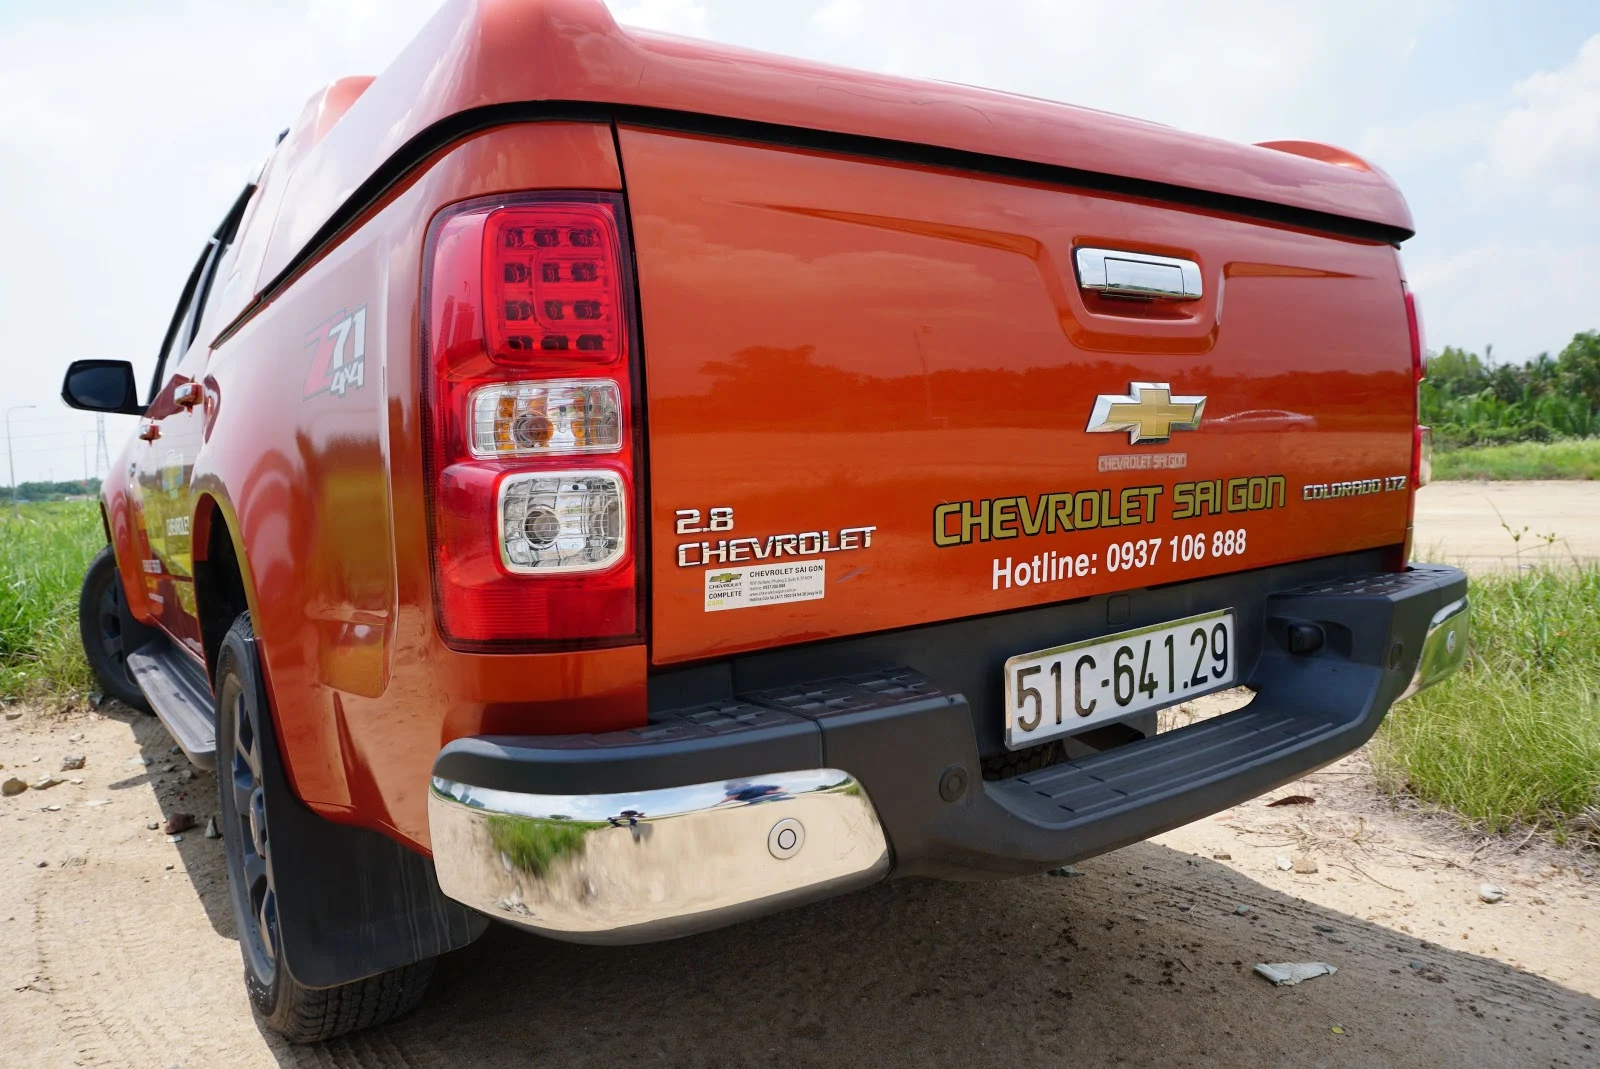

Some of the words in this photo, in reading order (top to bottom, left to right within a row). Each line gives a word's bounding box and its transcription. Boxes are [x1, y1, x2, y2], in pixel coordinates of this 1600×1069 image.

[303, 302, 367, 402] Z71
[1303, 479, 1381, 500] COLORADO
[1384, 476, 1406, 492] LTZ
[675, 507, 734, 534] 2.8
[932, 485, 1163, 548] CHEVROLET
[1172, 478, 1222, 520] SAI
[1226, 475, 1286, 512] GON
[678, 526, 877, 567] CHEVROLET
[992, 552, 1098, 591] Hotline:
[1106, 538, 1162, 573] 0937
[1169, 532, 1206, 563] 106
[1211, 528, 1247, 558] 888
[709, 582, 742, 590] CHEVROLET
[749, 567, 793, 578] CHEVROLET
[708, 590, 742, 599] COMPLETE
[1017, 622, 1228, 732] 51C-641.29
